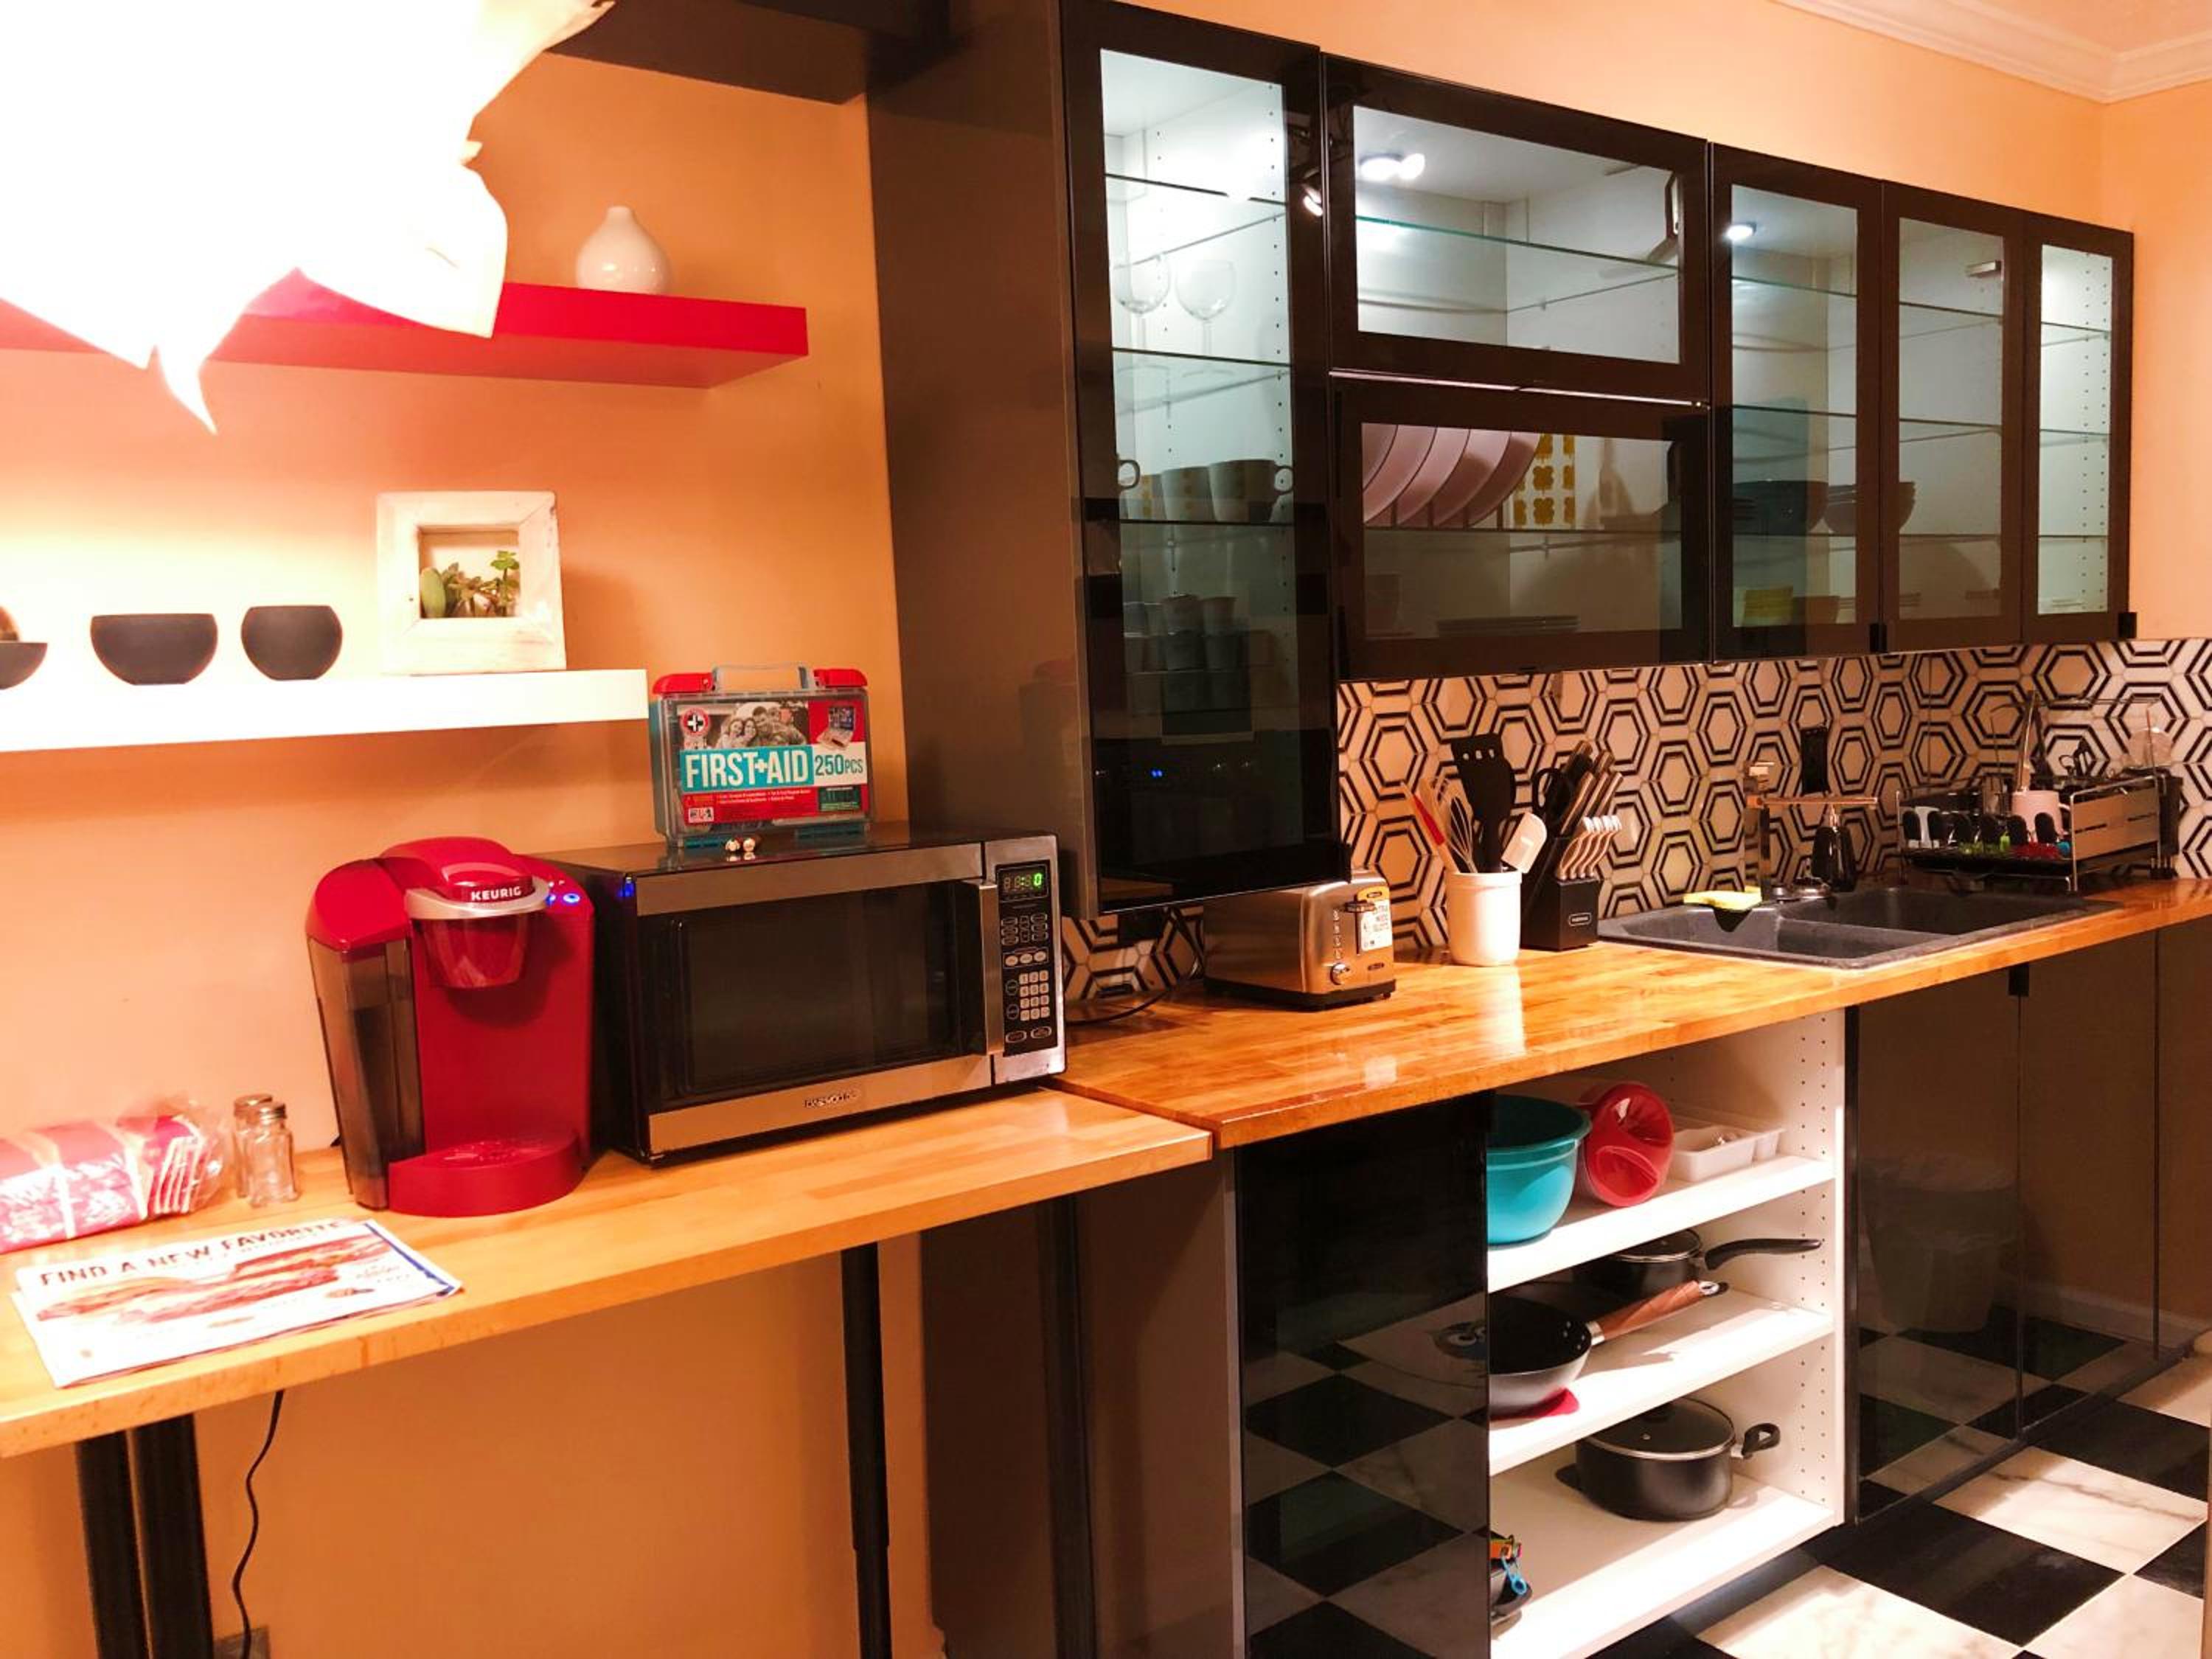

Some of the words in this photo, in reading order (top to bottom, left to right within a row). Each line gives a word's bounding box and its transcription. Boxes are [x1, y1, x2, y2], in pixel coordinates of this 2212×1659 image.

[471, 886, 521, 901] KEURIG
[40, 1266, 108, 1286] FIND
[120, 1262, 138, 1273] A
[147, 1245, 210, 1267] NEW
[221, 1222, 339, 1250] FAVORITE
